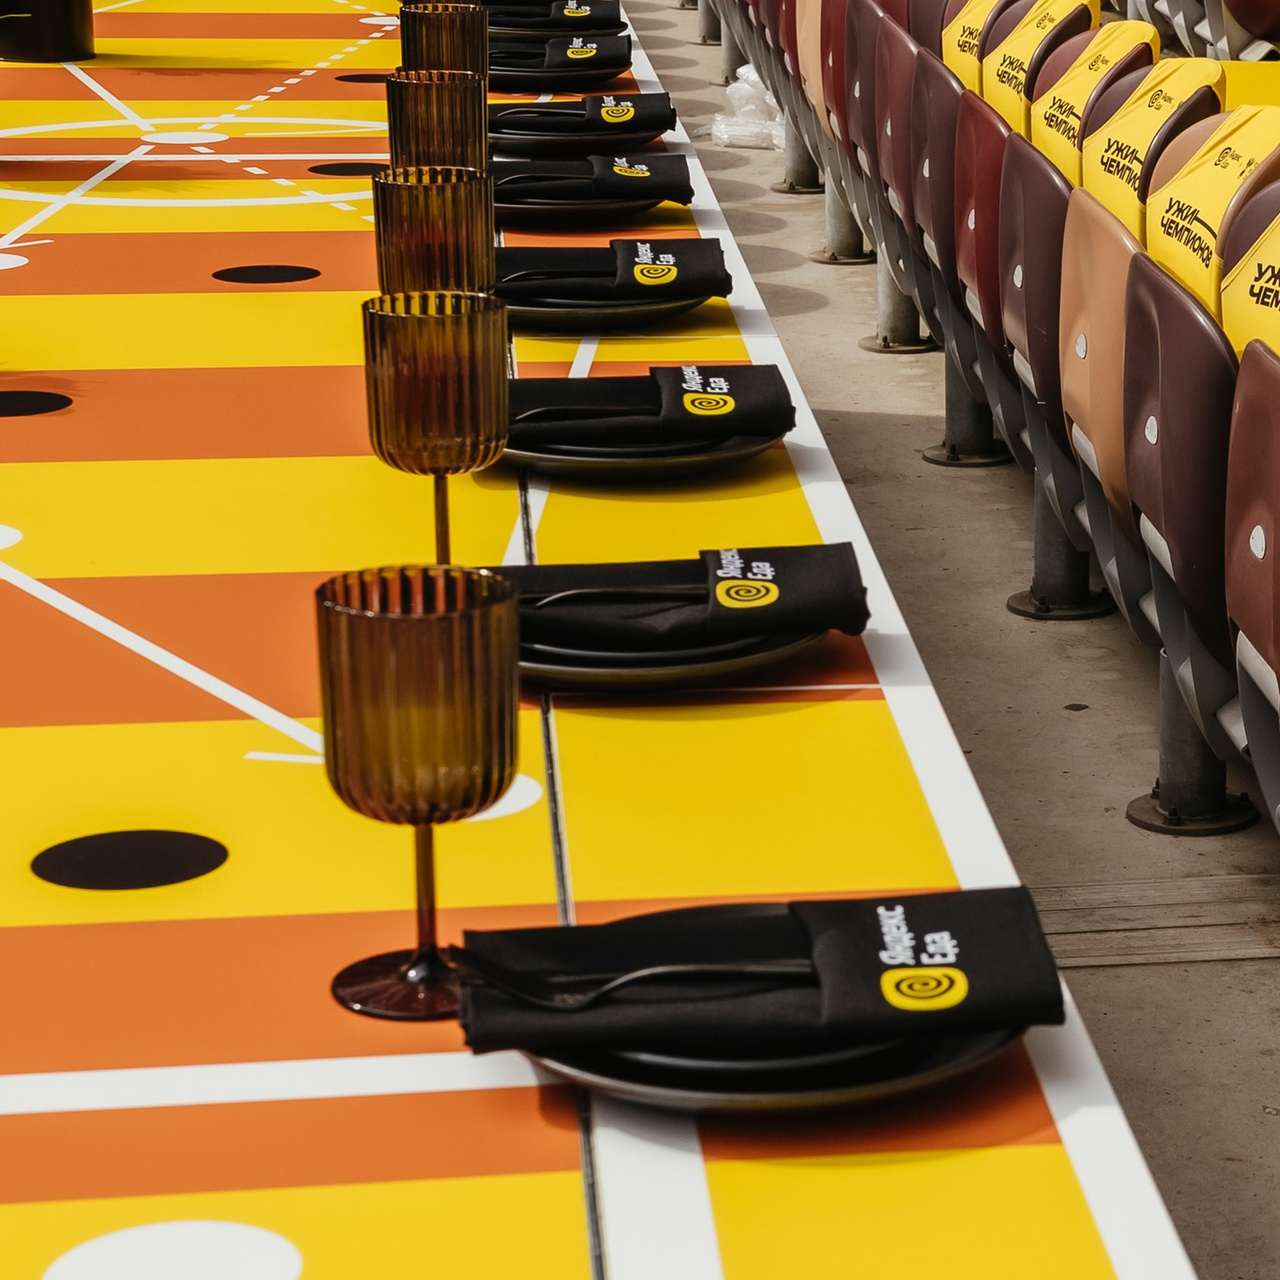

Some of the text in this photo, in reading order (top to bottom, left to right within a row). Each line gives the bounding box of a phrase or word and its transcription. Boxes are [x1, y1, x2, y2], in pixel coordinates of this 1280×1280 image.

[1160, 215, 1213, 269] ЧЕМПИОНОВ
[746, 561, 776, 580] Еда
[876, 904, 916, 966] Яндекс
[919, 930, 960, 965] Еда
